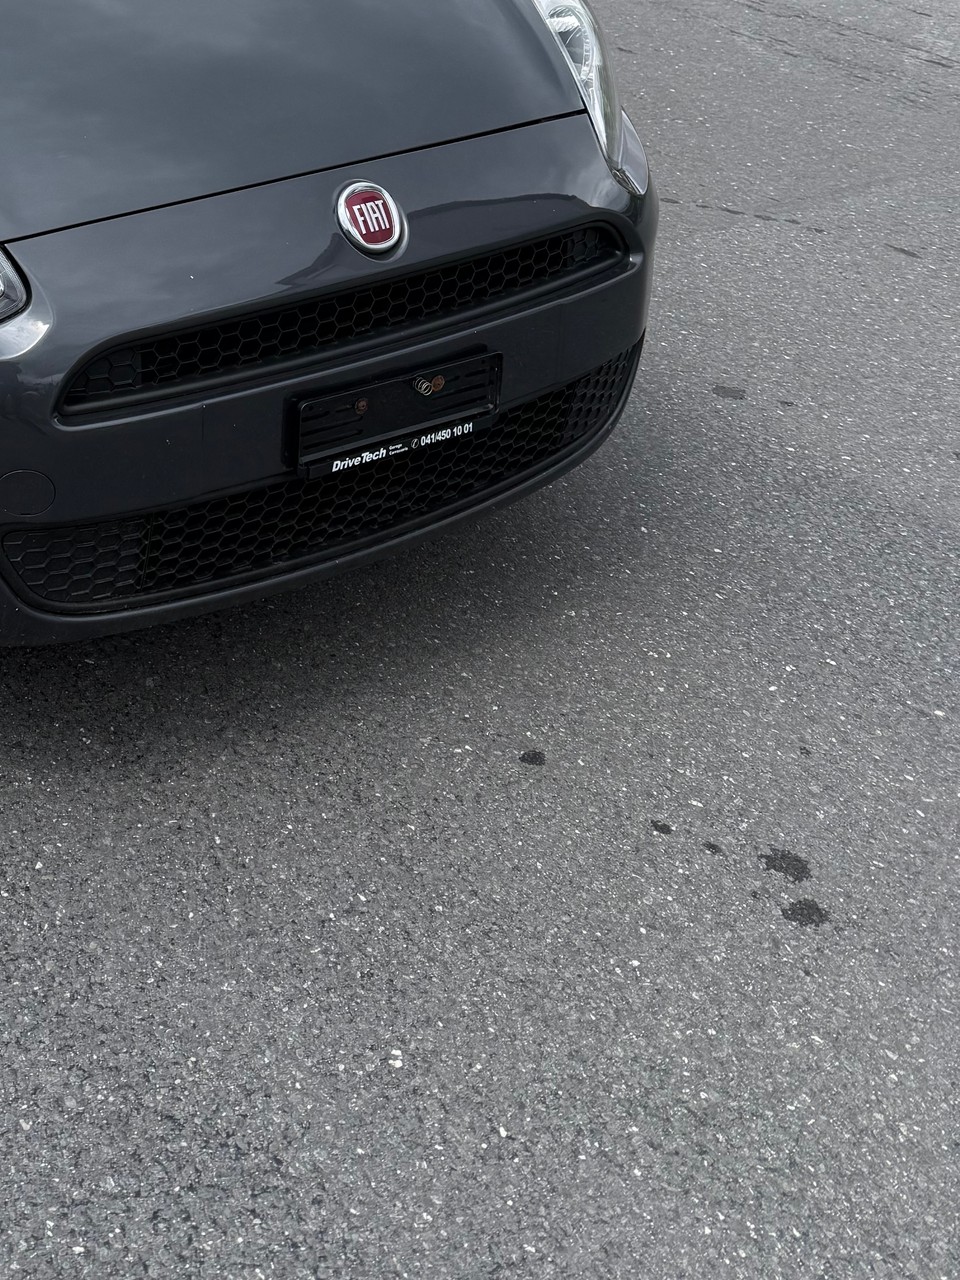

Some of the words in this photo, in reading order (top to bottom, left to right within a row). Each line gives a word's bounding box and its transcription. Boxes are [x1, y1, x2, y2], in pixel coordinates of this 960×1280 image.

[352, 199, 390, 235] FIAT
[420, 428, 452, 446] 041/450
[452, 425, 463, 437] 10
[463, 422, 473, 434] 01
[331, 447, 387, 473] DriveTech
